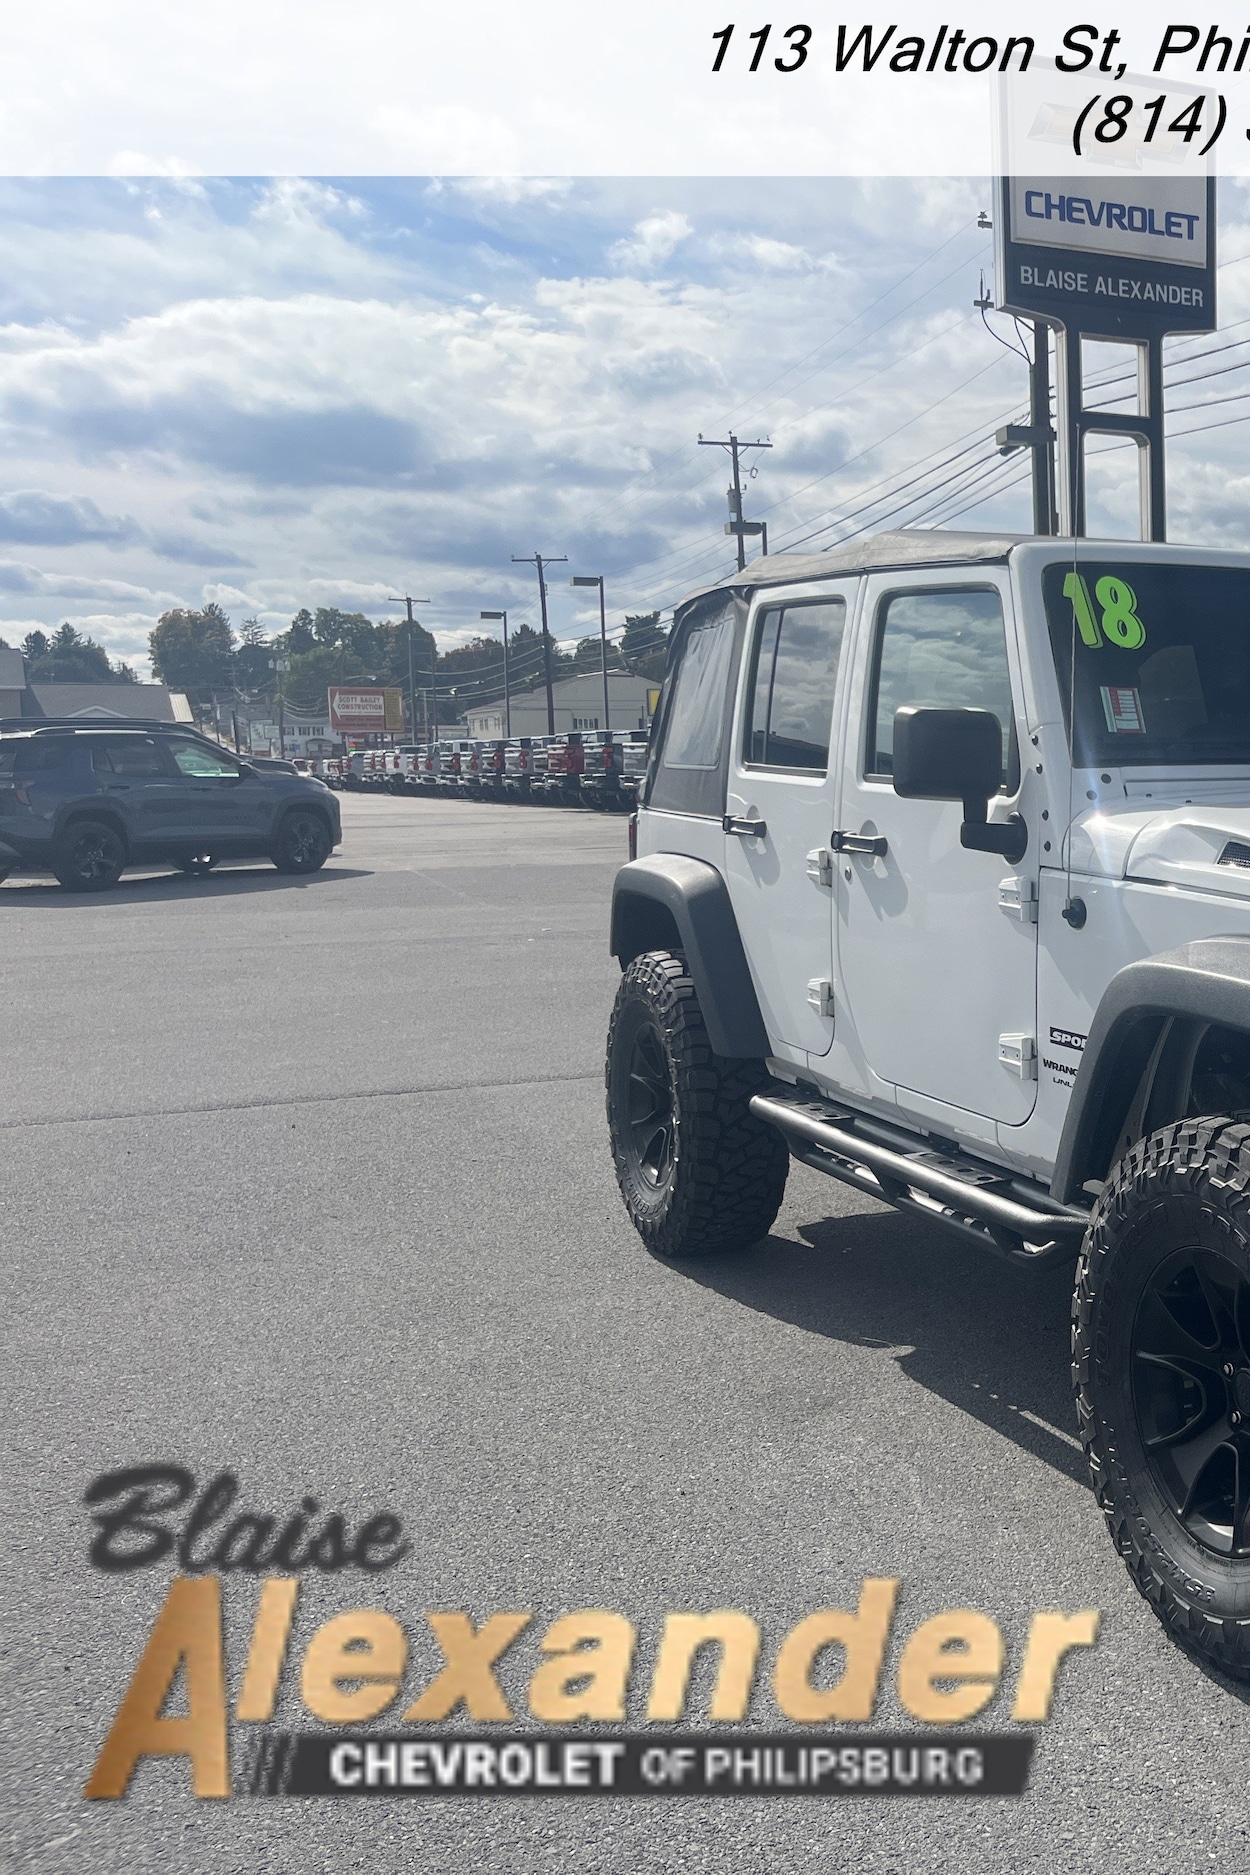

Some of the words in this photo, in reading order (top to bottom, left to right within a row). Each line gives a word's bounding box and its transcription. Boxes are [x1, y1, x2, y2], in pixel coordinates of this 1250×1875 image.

[1024, 190, 1200, 241] CHEVROLET
[1019, 265, 1089, 293] BLAISE
[1094, 276, 1204, 308] ALEXANDER
[1062, 572, 1147, 650] 18
[337, 703, 383, 711] CONSTRUCTION
[339, 696, 357, 704] SCOTT
